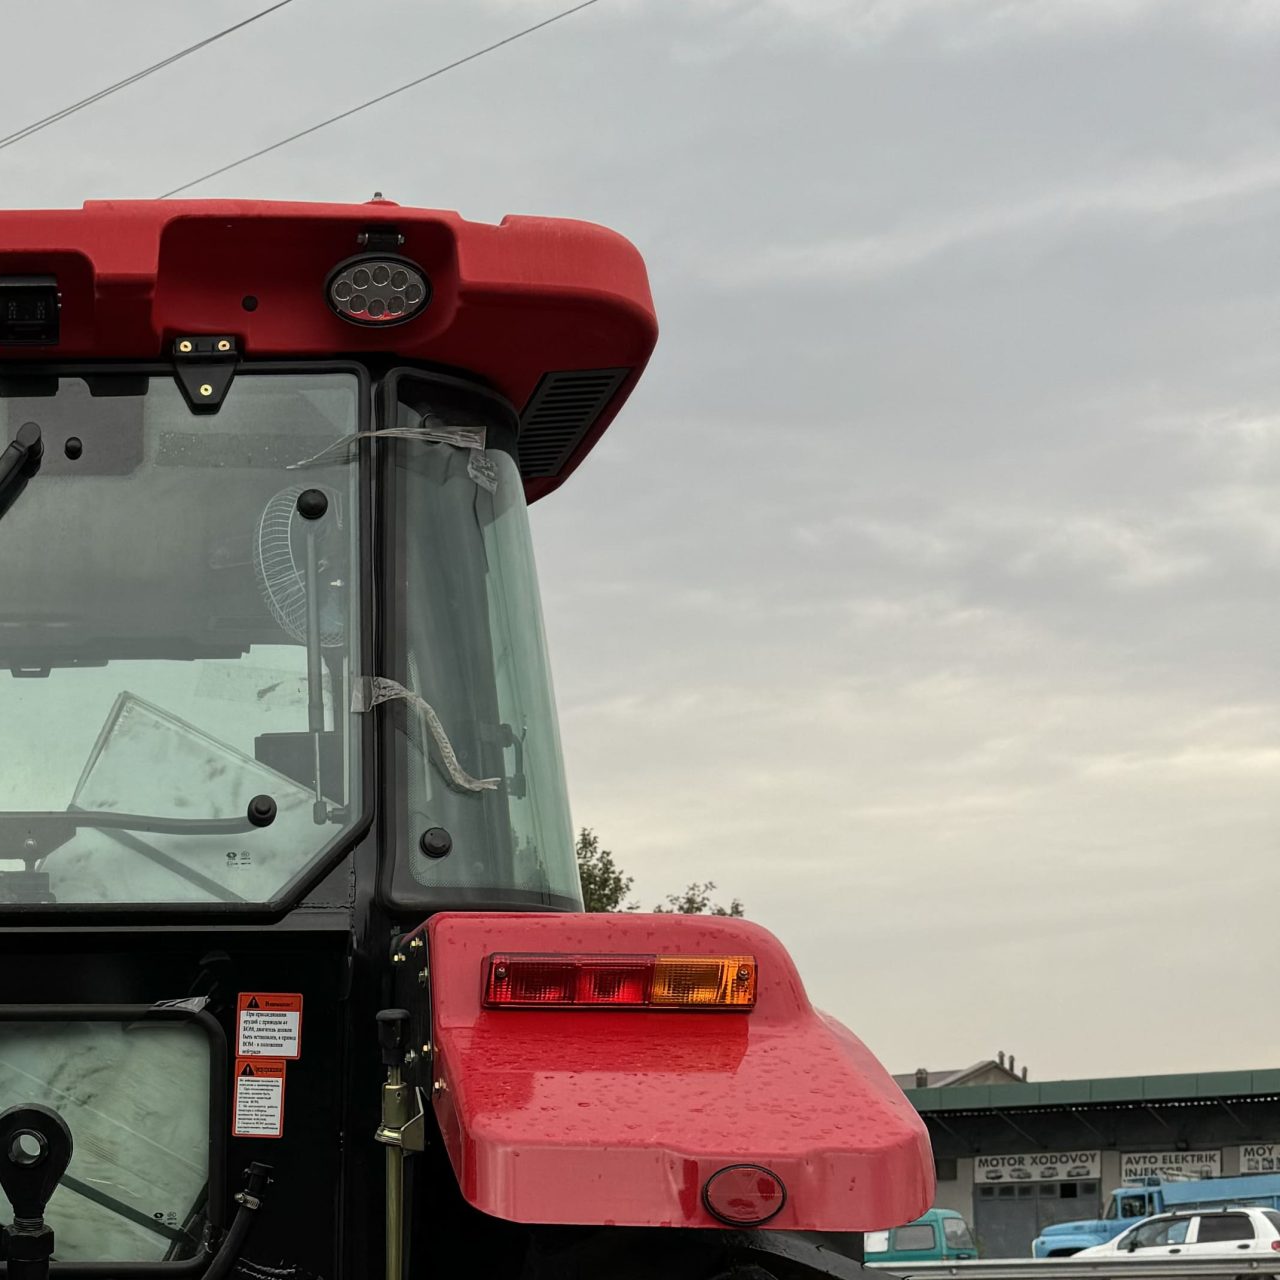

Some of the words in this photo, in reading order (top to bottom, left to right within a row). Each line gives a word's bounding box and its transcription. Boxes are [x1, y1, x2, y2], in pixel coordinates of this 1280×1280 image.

[978, 1156, 1025, 1168] MOTOR
[1030, 1152, 1097, 1166] XODOVOY
[1125, 1154, 1158, 1165] AVTO
[1162, 1152, 1217, 1164] ELEKTRIK
